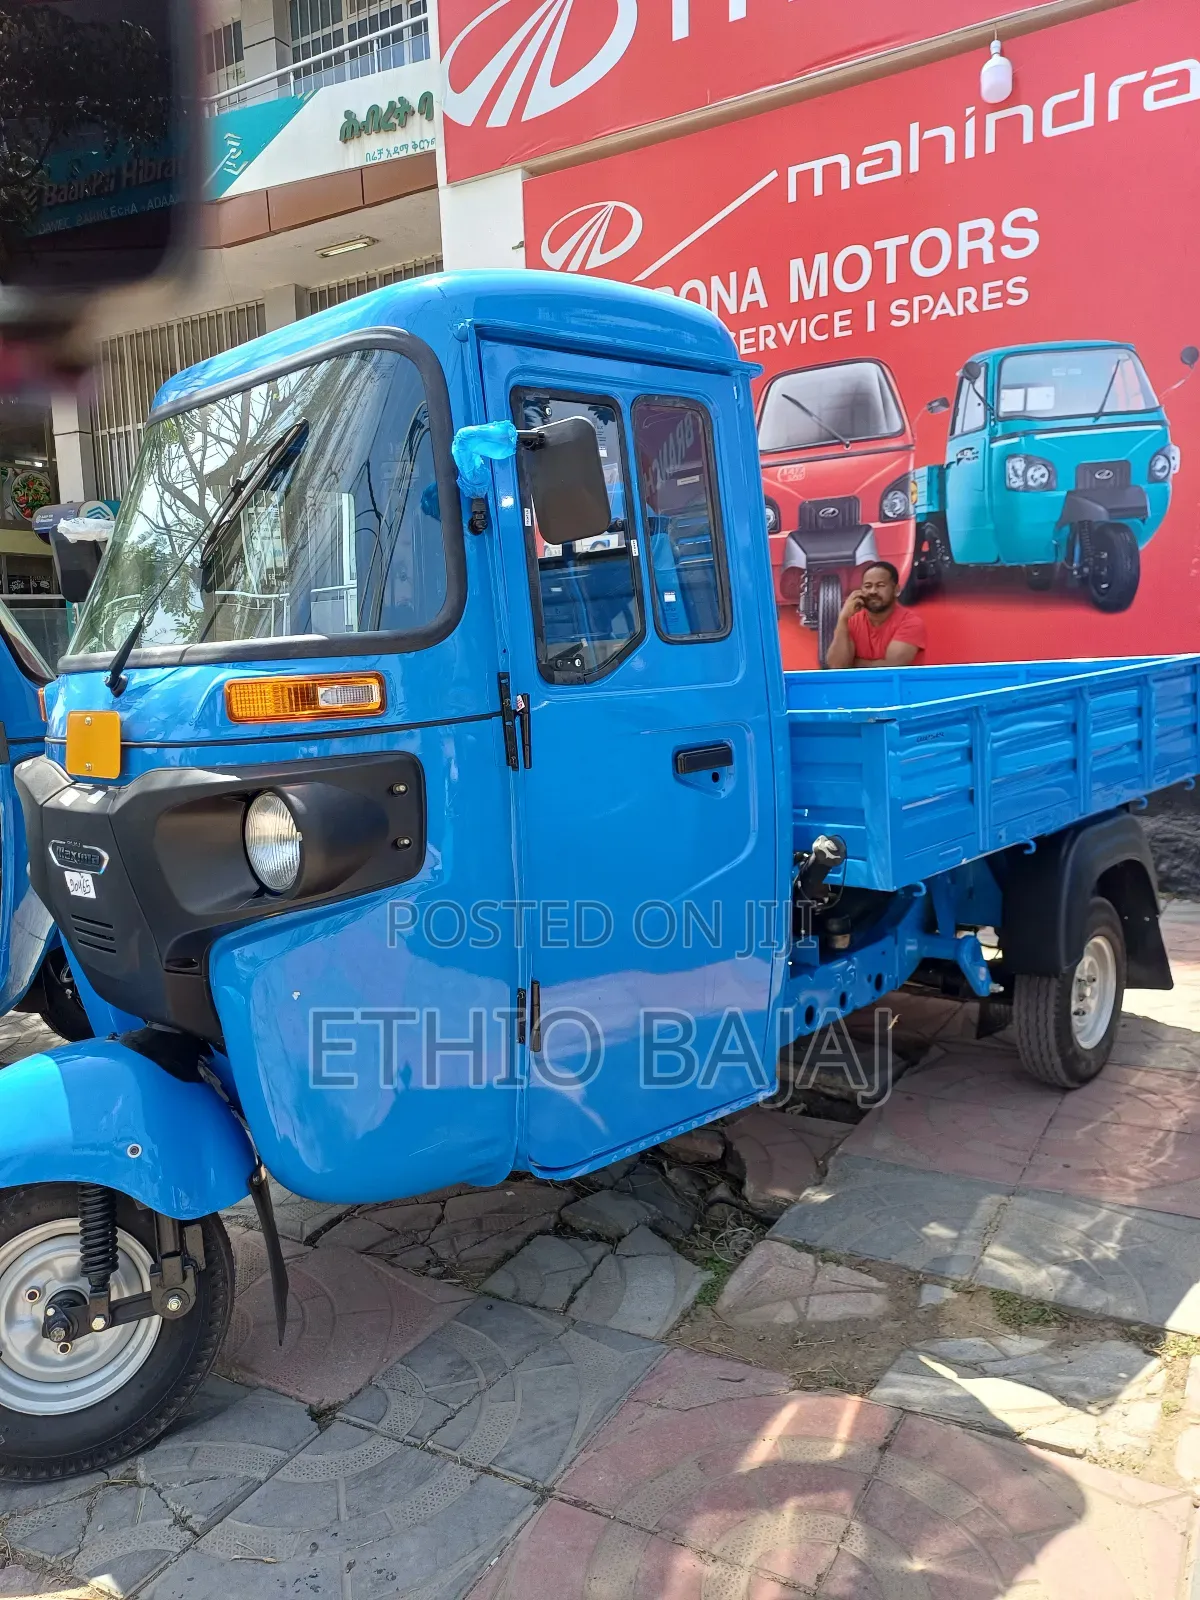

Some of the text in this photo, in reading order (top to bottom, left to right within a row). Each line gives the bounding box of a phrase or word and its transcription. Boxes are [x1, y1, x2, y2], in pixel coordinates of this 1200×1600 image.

[787, 58, 1200, 203] mahindra
[653, 207, 1040, 317] ONA MOTORS
[731, 308, 853, 355] ERVICE
[889, 276, 1030, 328] SPARES
